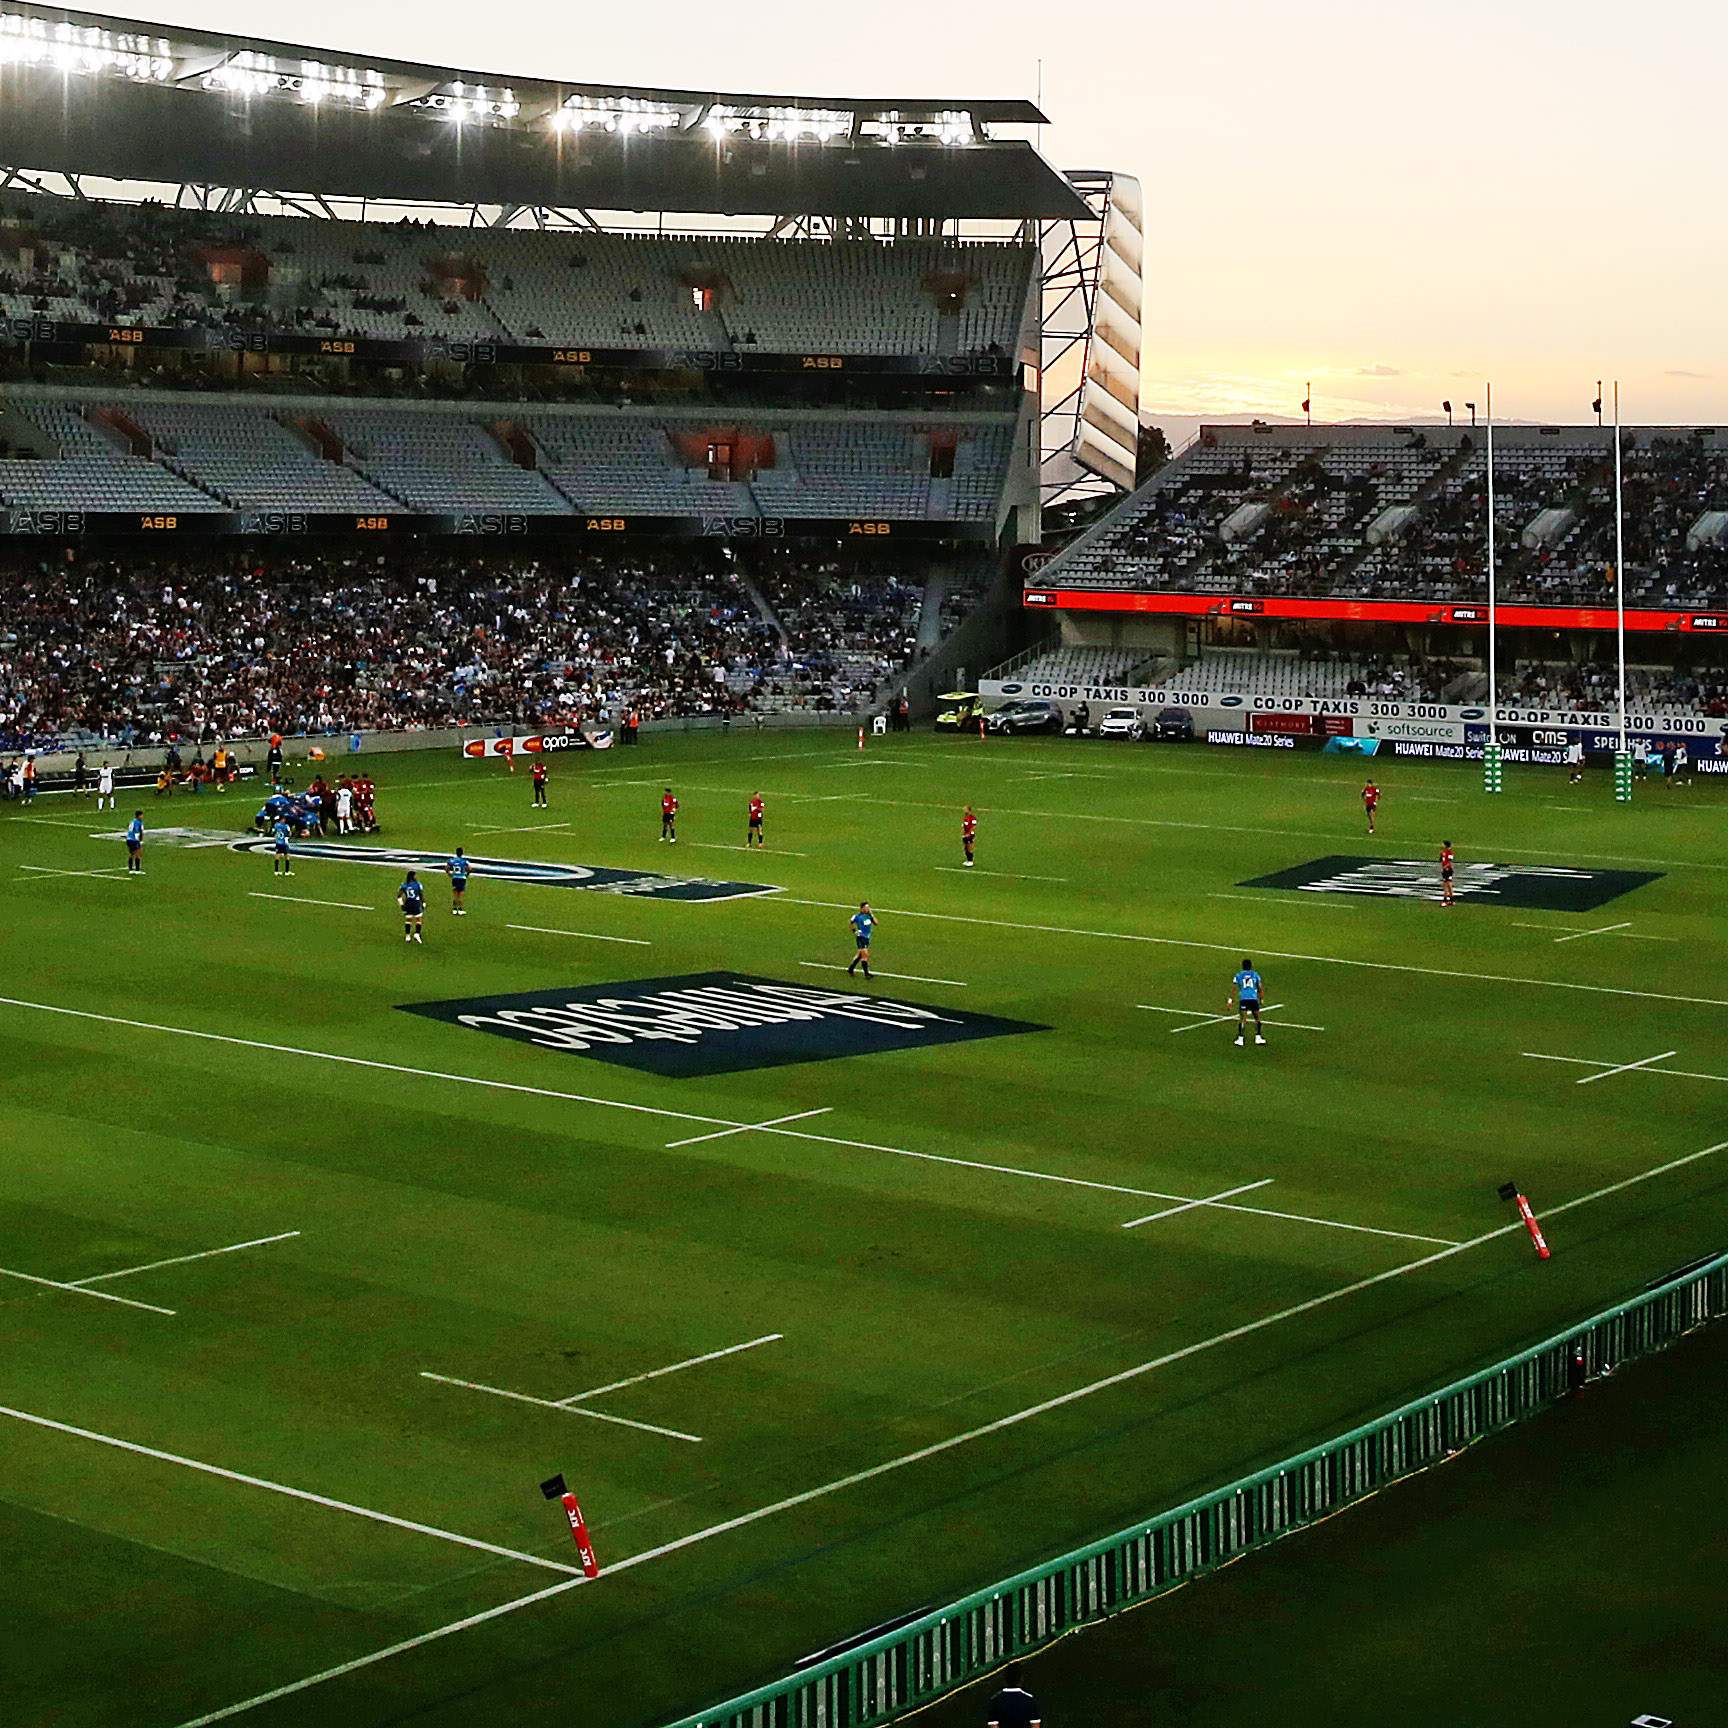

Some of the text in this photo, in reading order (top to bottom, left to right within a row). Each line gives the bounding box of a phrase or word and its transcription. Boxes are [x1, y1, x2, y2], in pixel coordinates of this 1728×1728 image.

[108, 328, 143, 344] ASB
[320, 340, 355, 355] ASB
[552, 351, 591, 363] ASB
[803, 357, 843, 369] ASB
[141, 516, 177, 530] ASB
[356, 517, 388, 530] ASB
[586, 519, 626, 531] ASB
[849, 523, 890, 534] ASB
[1032, 685, 1209, 706] CO-OP TAXIS 300 3000
[1254, 697, 1447, 719] CO-OP TAXIS 300 3000
[1496, 709, 1705, 732] CO-OP TAXIS 300 3000
[1388, 723, 1453, 738] softsource
[543, 736, 568, 751] opro
[1208, 731, 1295, 748] HUAWEI Mate20 Series
[1395, 743, 1484, 759] HUAWEI Mate20 Serie
[1532, 750, 1561, 763] Mate20
[1243, 978, 1253, 988] 14
